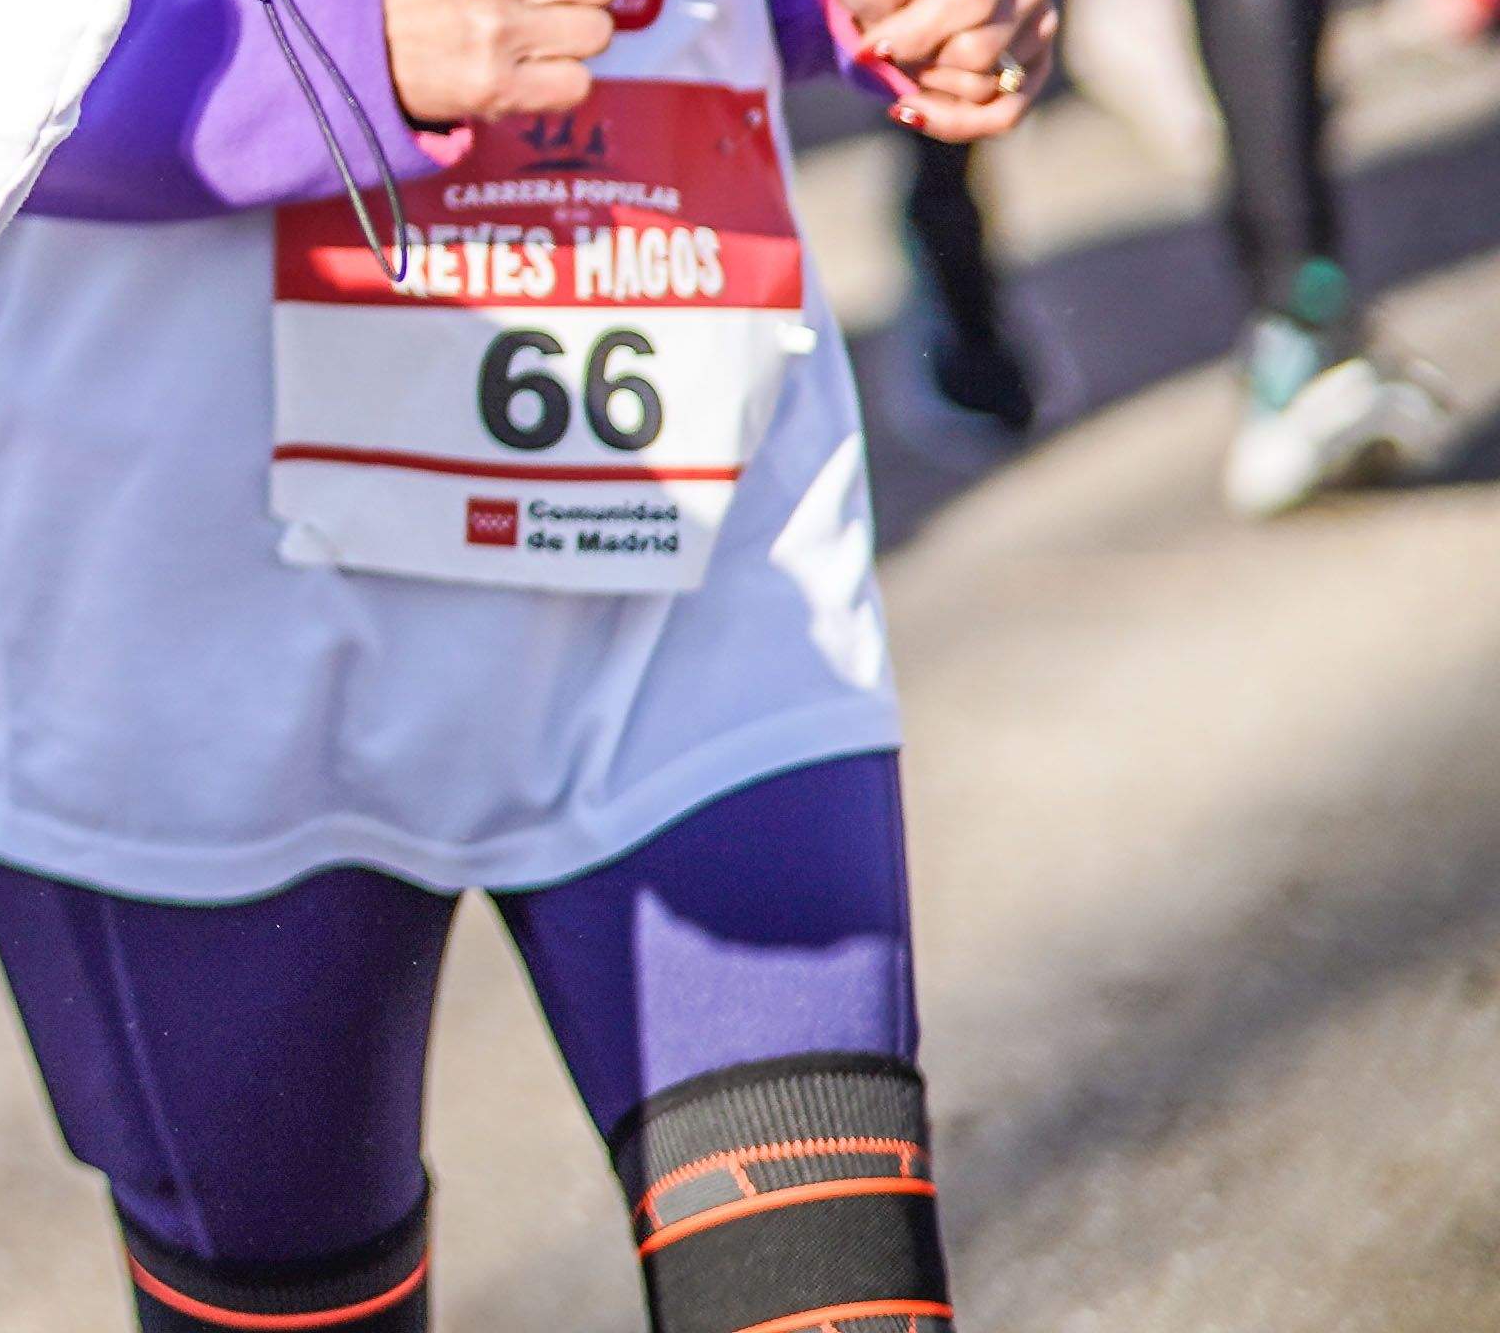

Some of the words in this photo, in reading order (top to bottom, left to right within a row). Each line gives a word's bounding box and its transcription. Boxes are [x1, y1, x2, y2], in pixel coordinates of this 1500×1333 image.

[442, 180, 568, 212] CARRERA
[572, 179, 681, 213] POPULAR
[390, 222, 556, 299] REYES
[574, 225, 725, 301] MAGOS
[480, 329, 664, 451] 66
[576, 530, 680, 554] Madrid
